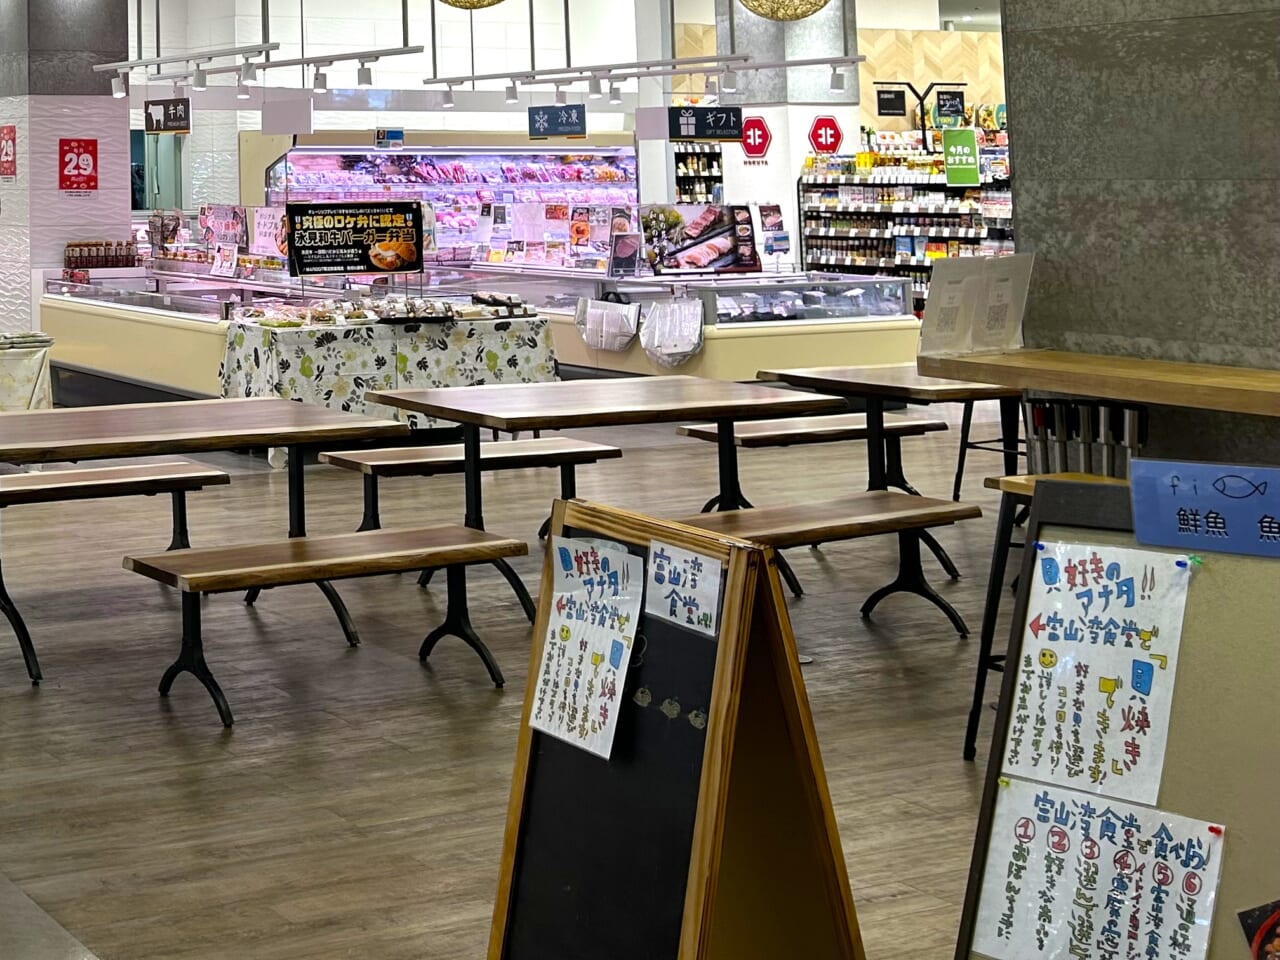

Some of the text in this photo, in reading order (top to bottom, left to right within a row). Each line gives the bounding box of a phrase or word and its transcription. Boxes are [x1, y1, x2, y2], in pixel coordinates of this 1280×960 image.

[168, 103, 185, 120] 牛肉
[558, 110, 580, 124] 冷凍
[705, 111, 737, 128] ギフト
[0, 140, 14, 161] 29
[949, 145, 970, 154] 今月の
[63, 153, 93, 175] 29
[1176, 507, 1229, 537] 鮮魚
[654, 547, 703, 589] 富山湾
